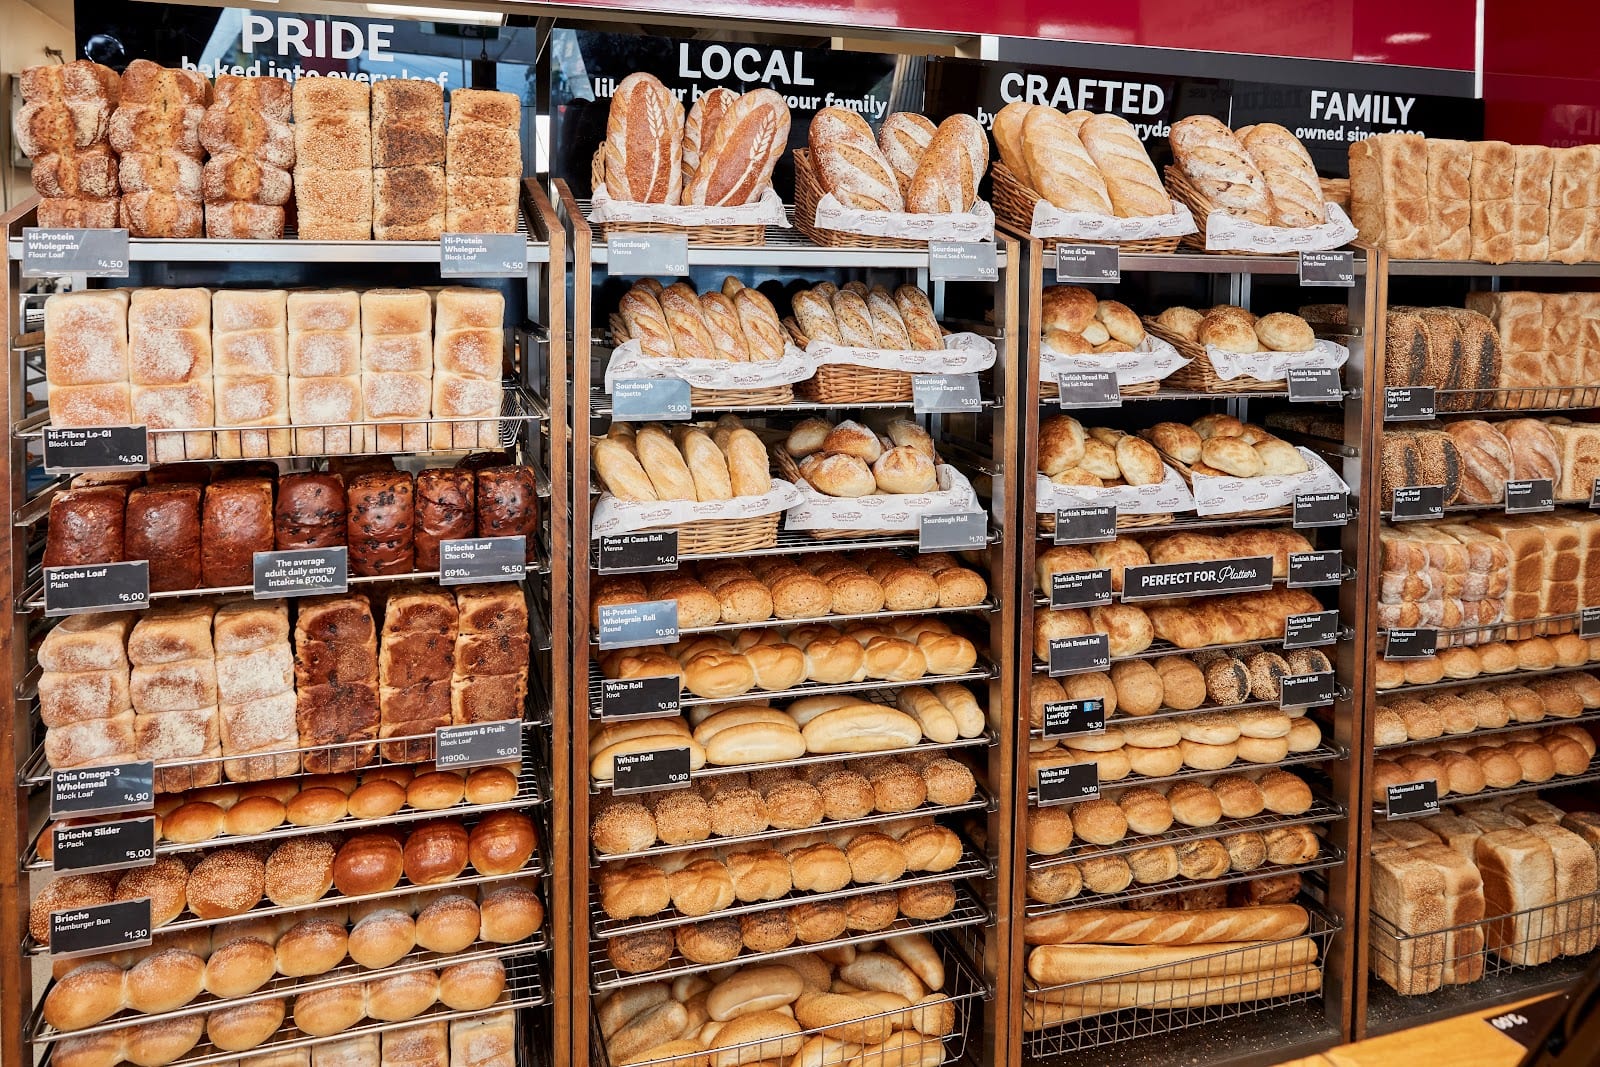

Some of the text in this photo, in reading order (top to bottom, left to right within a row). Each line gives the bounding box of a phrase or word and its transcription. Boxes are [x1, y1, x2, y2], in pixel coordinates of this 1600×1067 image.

[242, 16, 394, 62] PRIDE
[680, 42, 815, 86] LOCAL
[1000, 72, 1164, 115] CRAFTED
[825, 92, 887, 119] family
[1310, 90, 1416, 124] FAMILY
[1296, 126, 1344, 140] owned
[29, 233, 75, 241] Hi-Protein
[29, 242, 80, 252] Wholegrain
[445, 245, 487, 254] Wholegrain
[612, 240, 650, 250] Sourdough
[99, 260, 124, 268] $4.50
[503, 262, 524, 270] $4.50
[616, 382, 653, 391] Sourdough
[48, 430, 85, 440] Hi-Fibre
[48, 440, 69, 448] Block
[119, 455, 144, 464] $4.90
[924, 516, 956, 525] Sourdough
[445, 542, 492, 552] Brioche Loaf
[461, 552, 476, 560] Chip
[276, 558, 326, 568] The average
[502, 564, 522, 572] $6.50
[52, 568, 108, 581] Brioche Loaf
[265, 566, 337, 578] adult daily energy
[1142, 566, 1257, 587] PERFECT FOR Platters
[52, 582, 70, 590] Plain
[268, 578, 296, 588] intake
[120, 592, 145, 602] $6.00
[602, 609, 638, 617] Hi-Protein
[602, 614, 656, 626] Wholegrain Roll
[606, 682, 643, 691] White Roll
[440, 726, 506, 740] Cinnamon & Fruit
[497, 747, 518, 756] $6.00
[617, 754, 654, 764] White Roll
[58, 768, 121, 782] Chia Omega-3
[58, 780, 108, 791] Wholemeal
[57, 790, 95, 800] Block Loaf
[125, 792, 150, 802] $4.90
[58, 826, 121, 841] Brioche Slider
[58, 840, 84, 850] 6-Pack
[126, 849, 151, 858] $5.00
[55, 912, 90, 924] Brioche
[55, 920, 95, 932] Hamburger
[124, 929, 148, 938] $1.30
